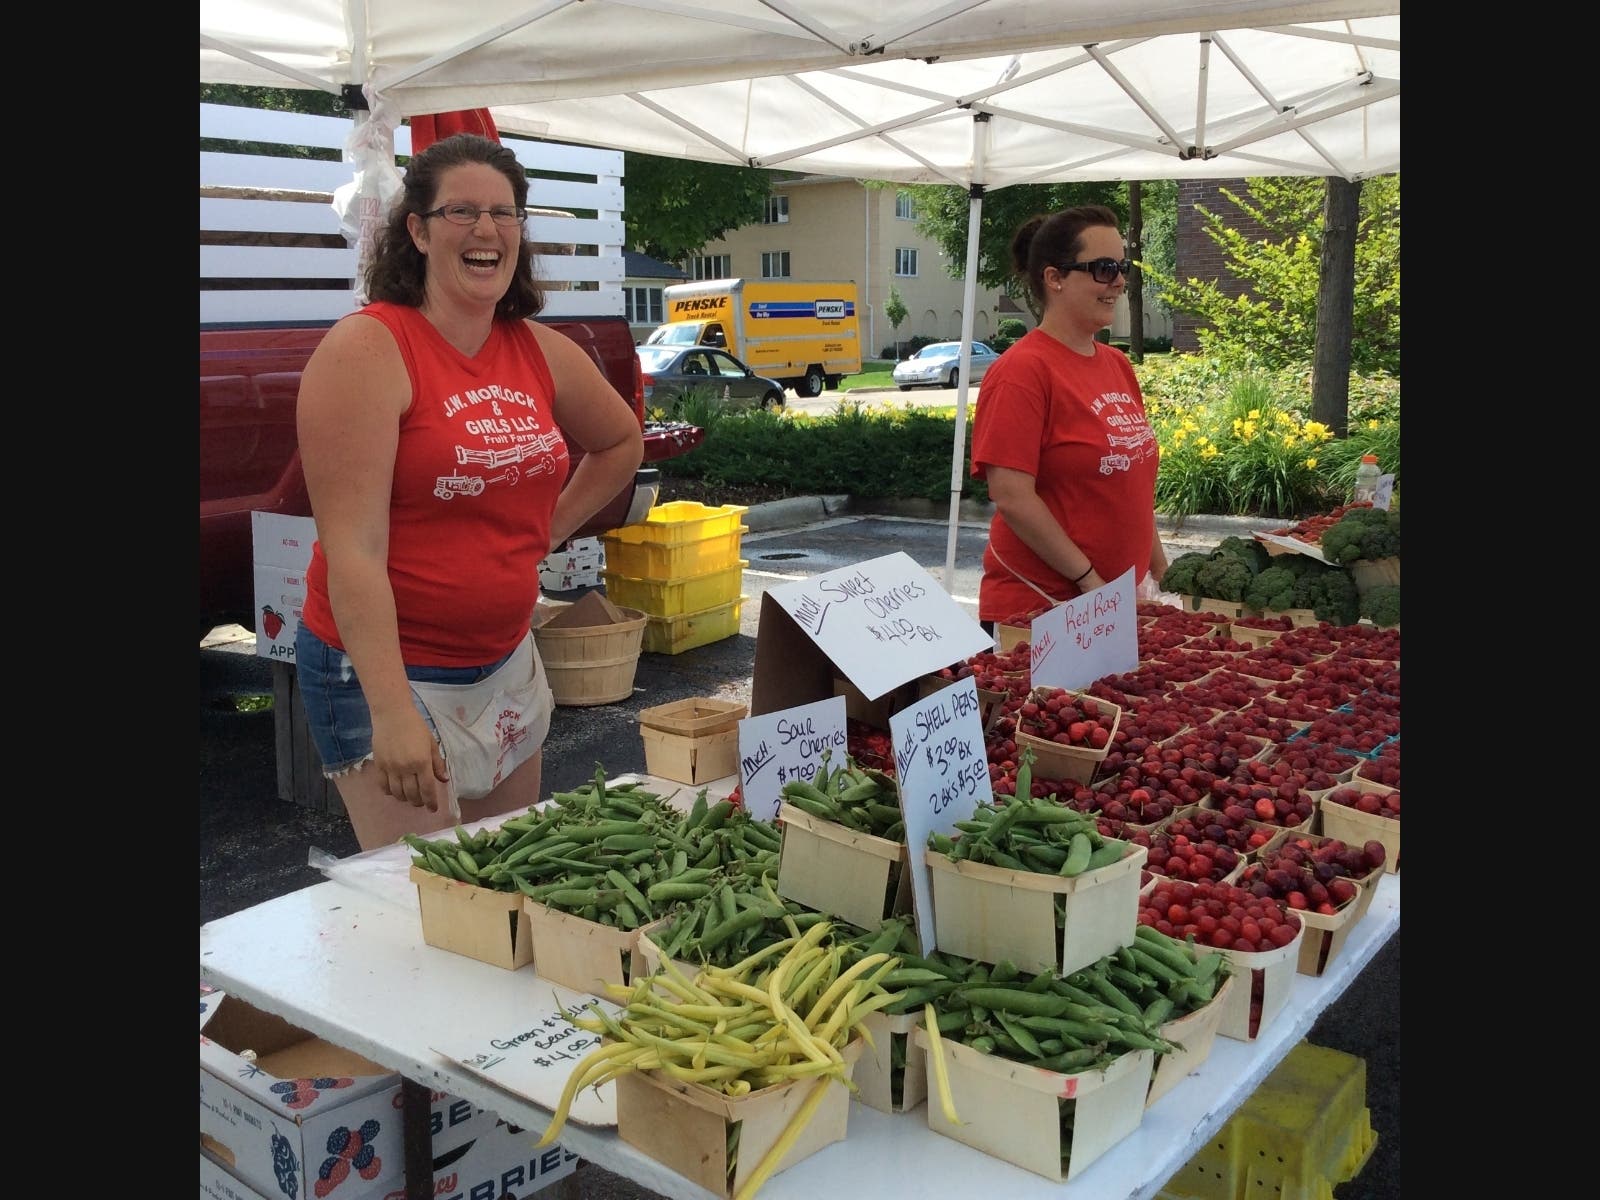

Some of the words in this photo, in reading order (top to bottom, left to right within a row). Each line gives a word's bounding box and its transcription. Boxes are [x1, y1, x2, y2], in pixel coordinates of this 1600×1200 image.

[675, 297, 728, 312] PENSKE
[443, 394, 468, 417] J.W.
[465, 385, 538, 413] MORLOCK
[491, 400, 503, 416] &
[465, 418, 511, 435] GIRLS
[511, 415, 540, 432] LLC
[1106, 414, 1132, 427] GIRLS
[483, 434, 508, 444] Fruit
[511, 433, 537, 443] Farm
[819, 571, 875, 603] Sweet
[864, 581, 926, 619] Cherries
[1065, 602, 1091, 634] Red
[1094, 592, 1121, 619] Rasp
[269, 644, 295, 659] APP
[916, 703, 952, 743] SHELL
[952, 689, 978, 720] PEAS
[800, 730, 846, 759] Cherries
[773, 798, 782, 818] 2
[929, 793, 942, 815] 2
[490, 1028, 546, 1050] Green
[535, 1027, 578, 1051] Bean
